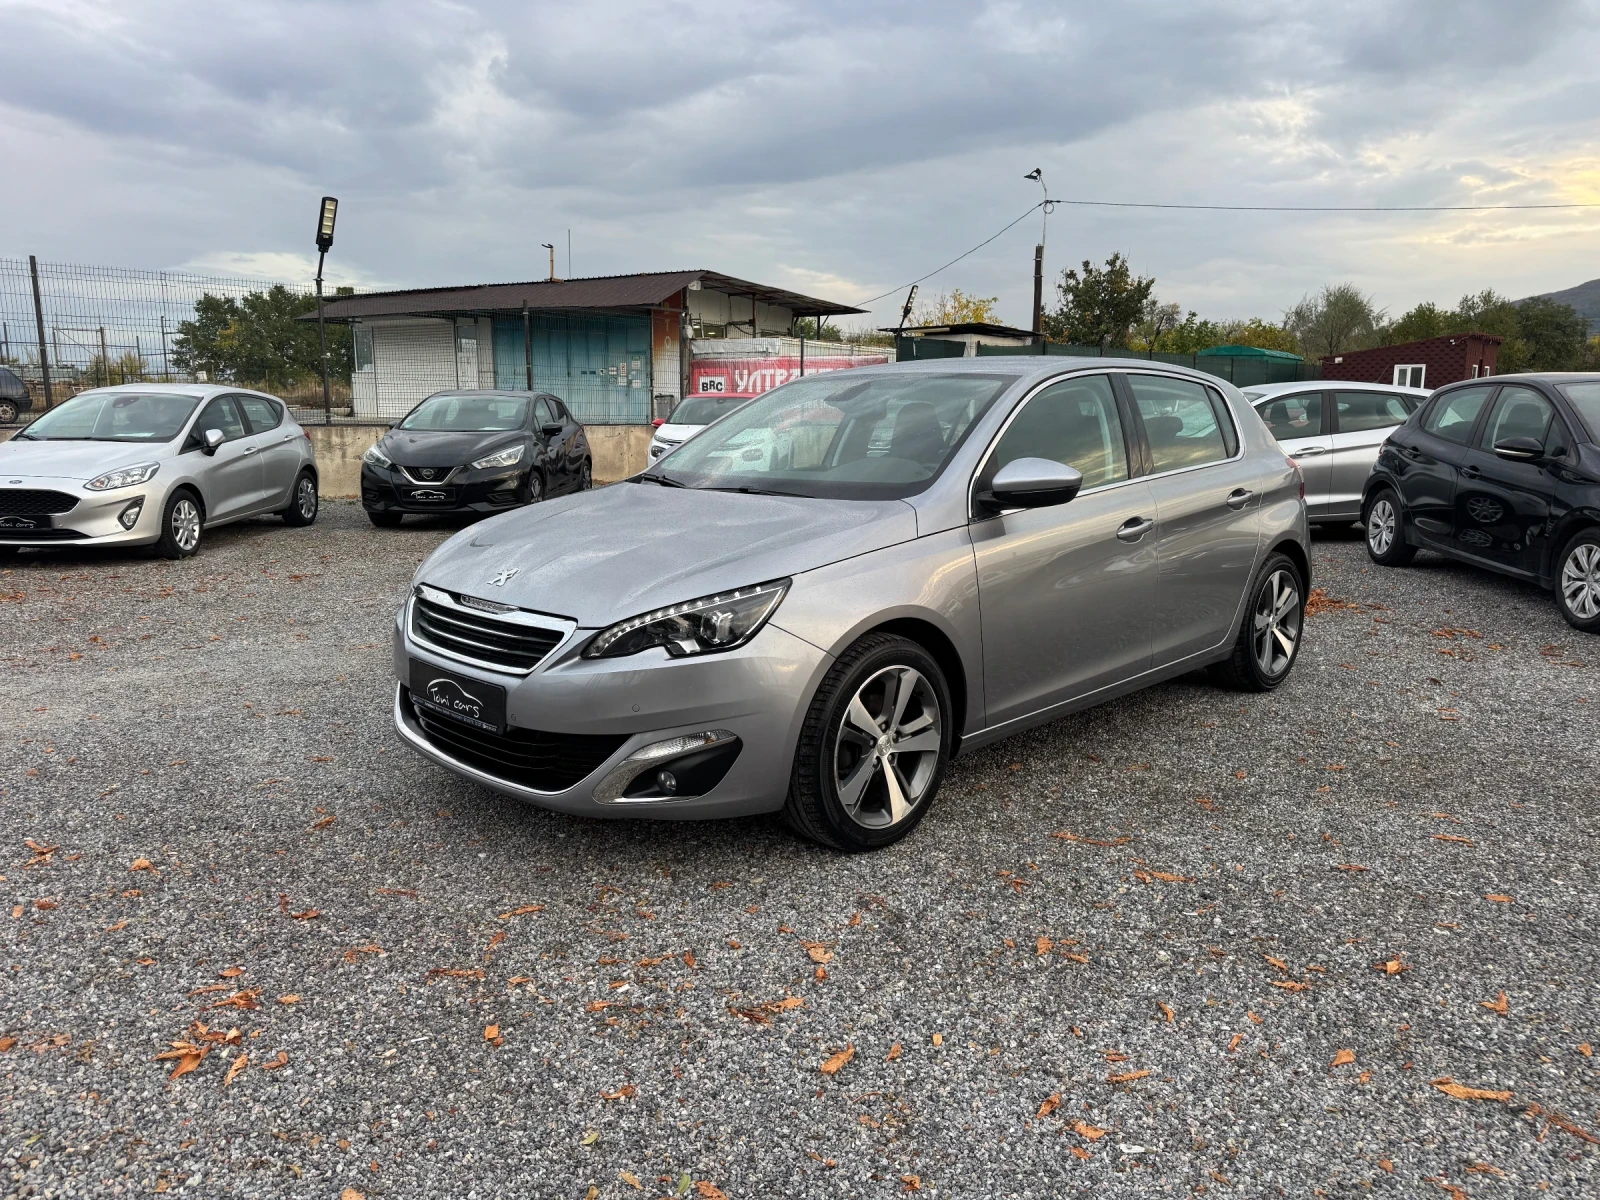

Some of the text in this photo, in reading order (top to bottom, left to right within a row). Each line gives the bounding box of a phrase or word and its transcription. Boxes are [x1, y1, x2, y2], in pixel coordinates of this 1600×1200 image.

[701, 380, 723, 392] BRC
[430, 687, 450, 706] Toni
[453, 700, 480, 718] cars
